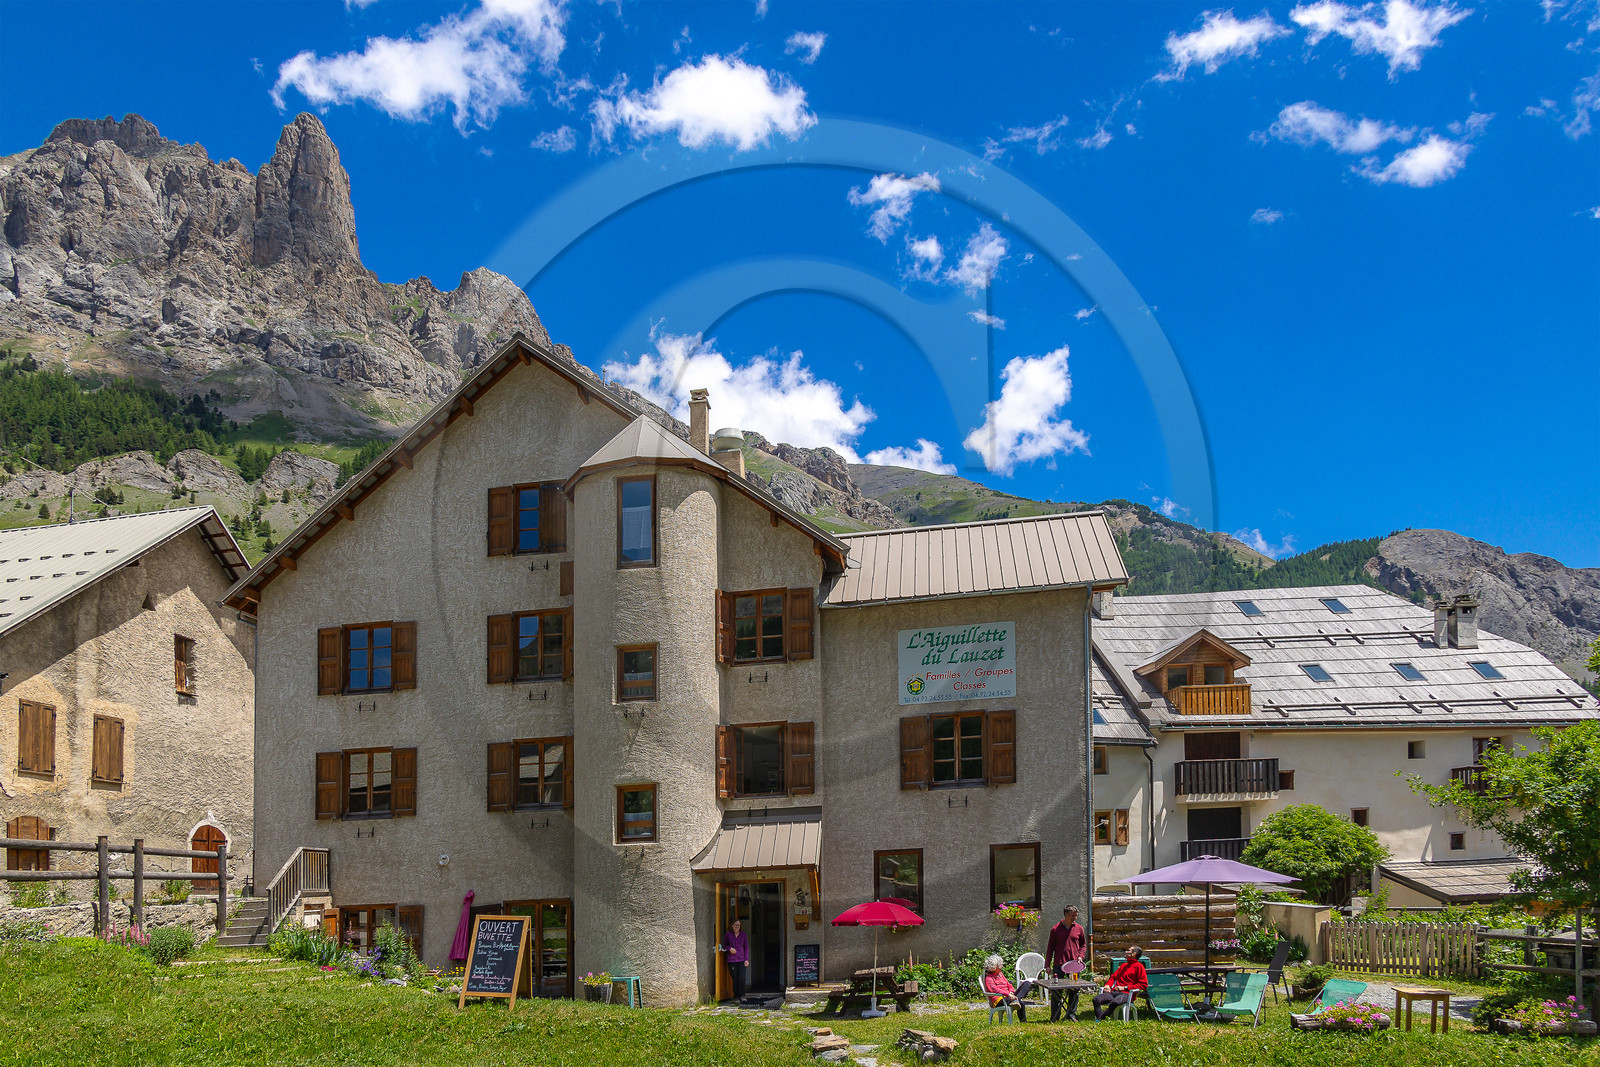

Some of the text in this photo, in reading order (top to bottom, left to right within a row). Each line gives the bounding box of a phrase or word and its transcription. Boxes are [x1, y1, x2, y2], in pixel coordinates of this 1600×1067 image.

[906, 626, 1007, 652] L'Aiguillette
[921, 647, 1005, 665] du Lauzet
[926, 671, 961, 680] Familles
[974, 667, 1013, 677] Groupes
[953, 681, 986, 690] Classes
[480, 921, 519, 933] OUVERT
[478, 932, 513, 941] BUVETTE
